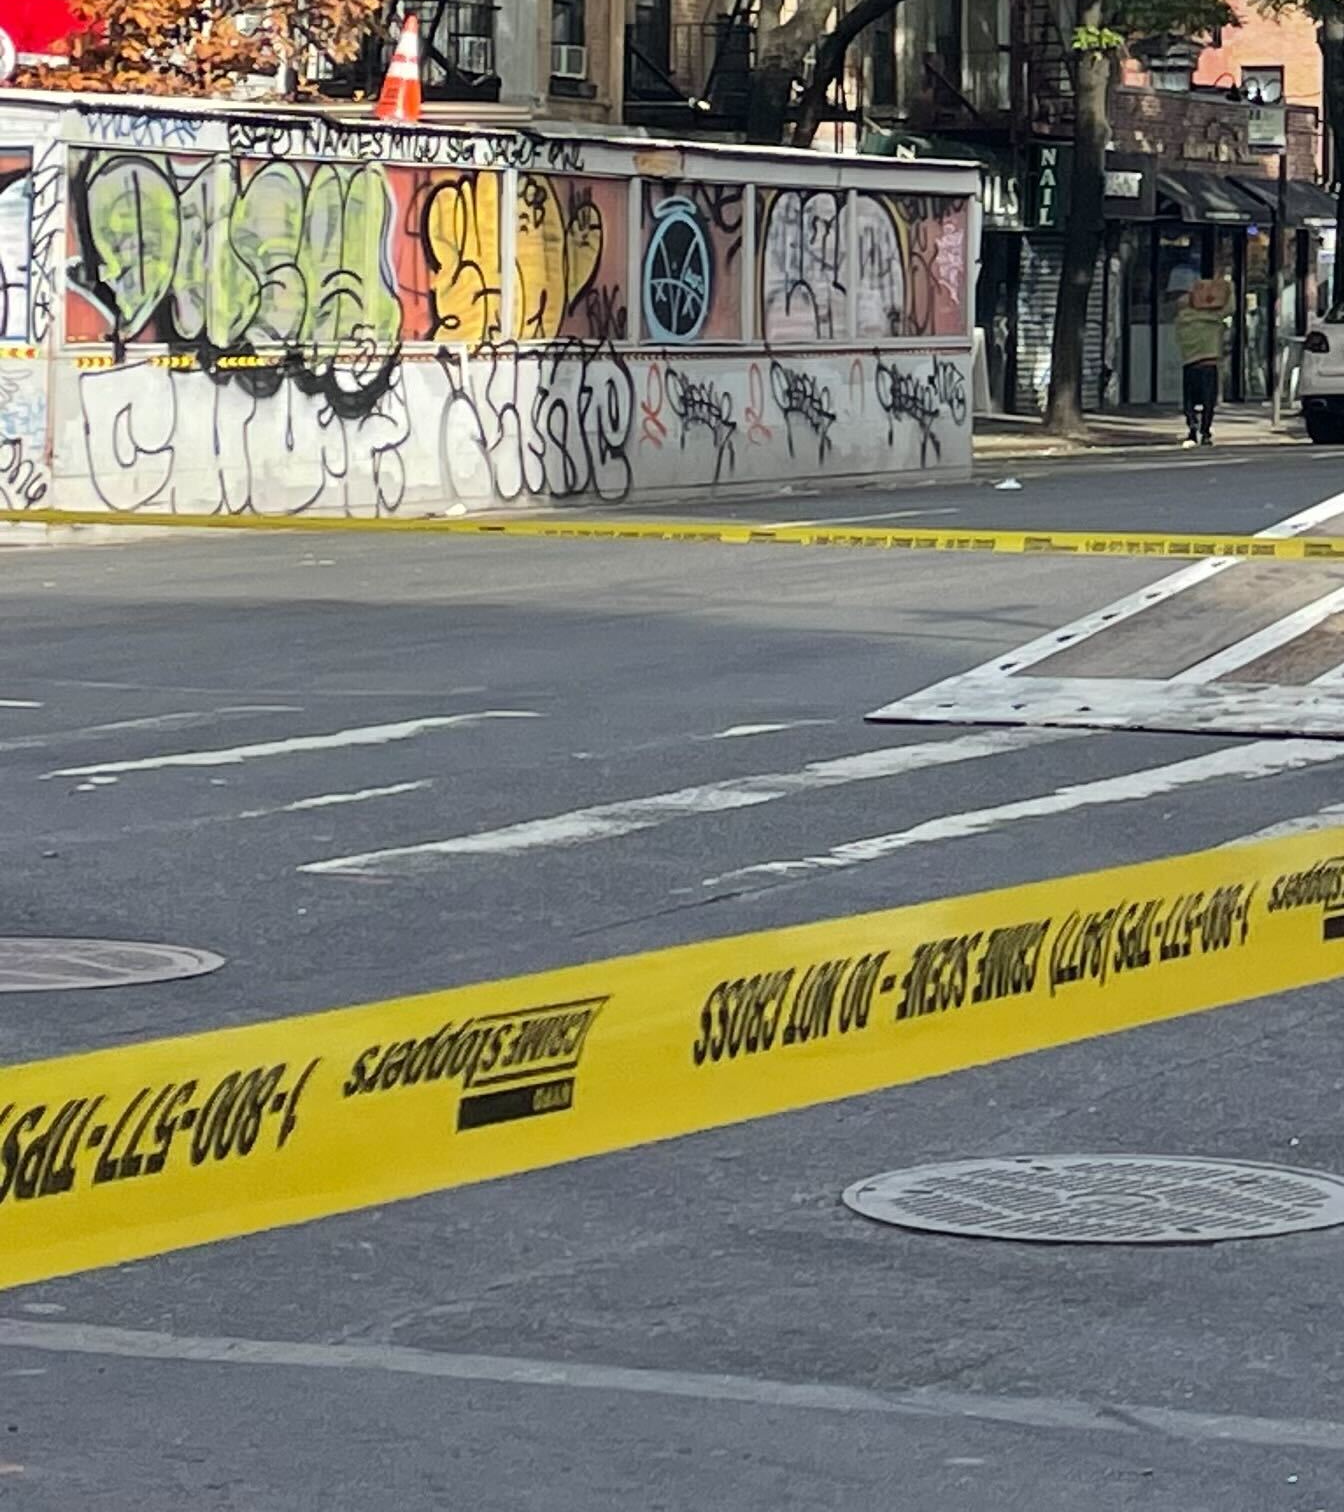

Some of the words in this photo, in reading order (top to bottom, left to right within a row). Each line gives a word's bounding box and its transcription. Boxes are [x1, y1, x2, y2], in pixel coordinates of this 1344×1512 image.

[1039, 148, 1057, 226] NAIL
[782, 956, 852, 1045] NOT
[839, 949, 891, 1033] DO
[896, 931, 983, 1021] SCENE
[972, 917, 1053, 1003] CRIME
[693, 966, 796, 1067] CROSS
